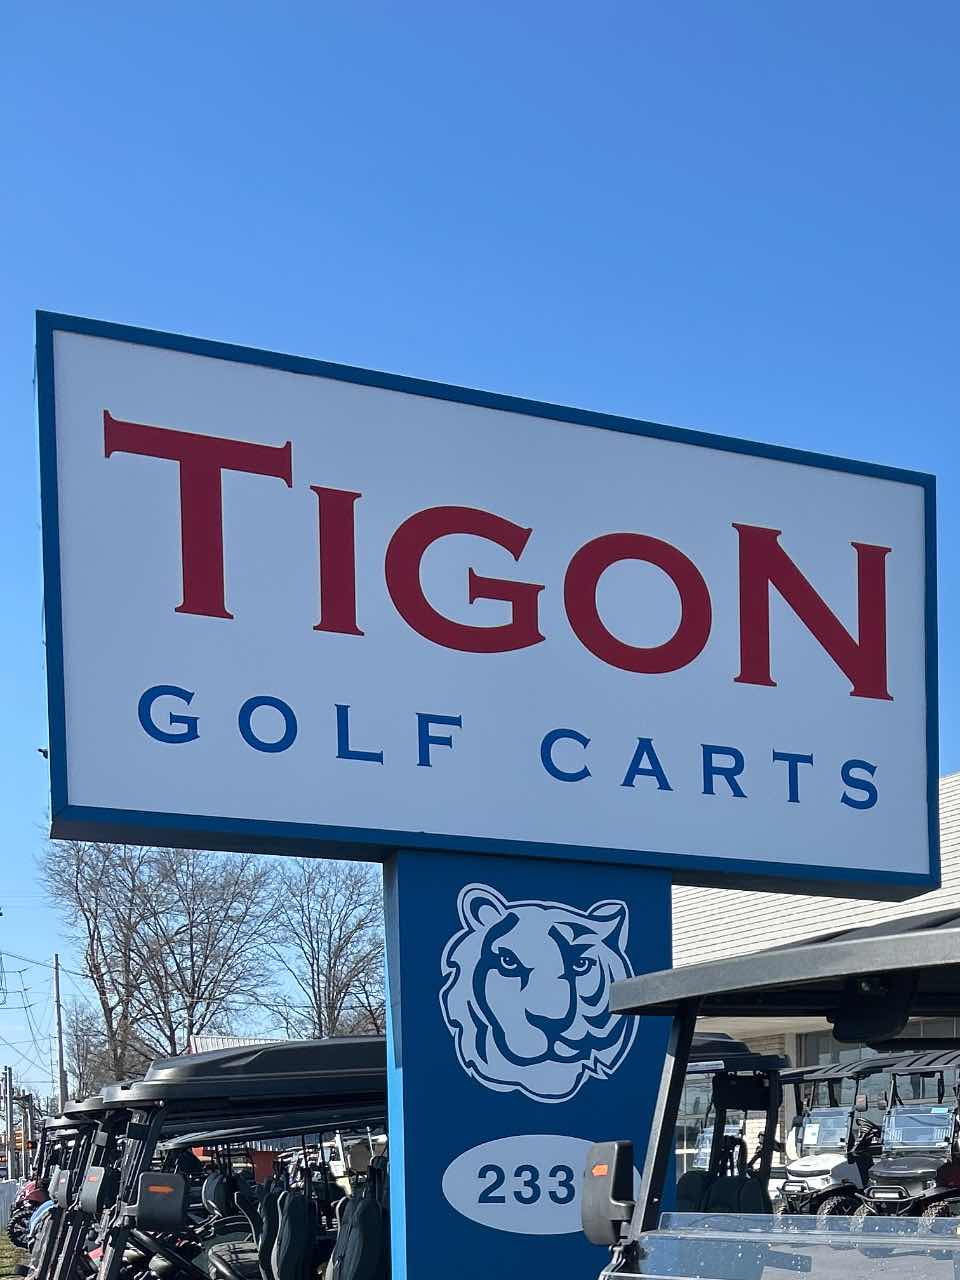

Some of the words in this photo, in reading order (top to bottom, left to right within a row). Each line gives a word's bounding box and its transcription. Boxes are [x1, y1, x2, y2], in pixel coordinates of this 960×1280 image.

[103, 410, 893, 701] TIGON
[137, 684, 463, 768] GOLF
[540, 728, 879, 810] CARTS
[477, 1163, 586, 1205] 233
